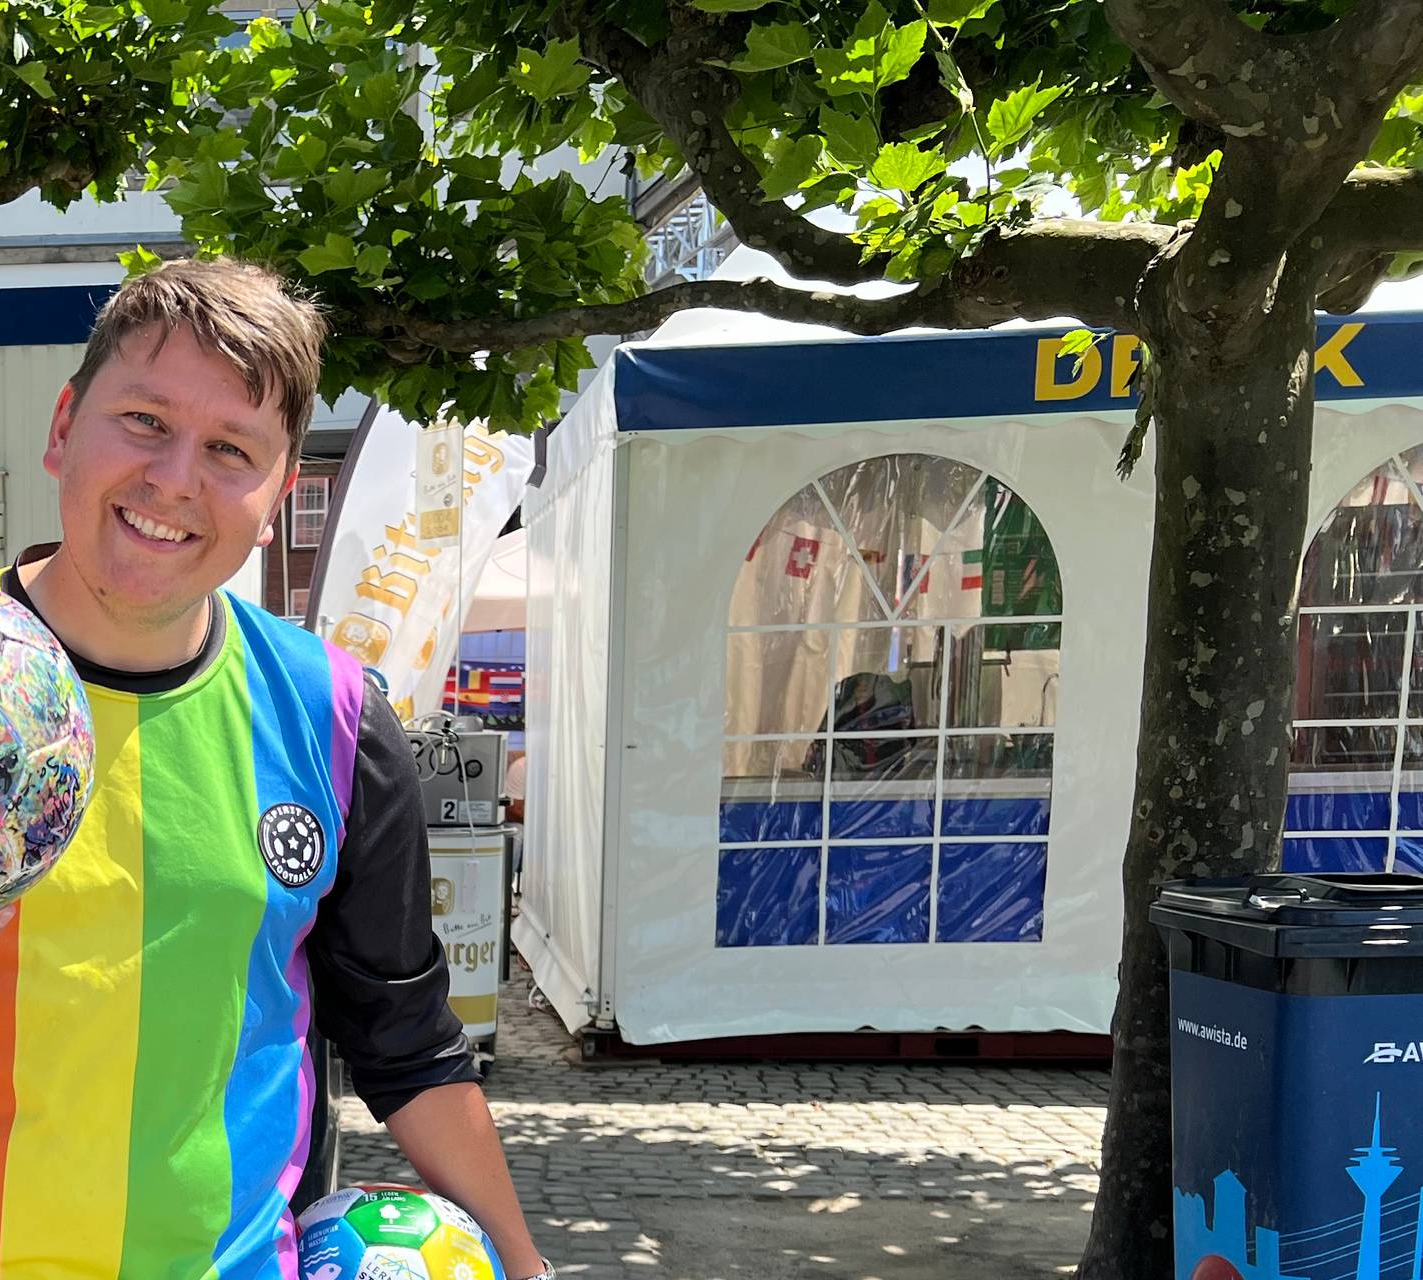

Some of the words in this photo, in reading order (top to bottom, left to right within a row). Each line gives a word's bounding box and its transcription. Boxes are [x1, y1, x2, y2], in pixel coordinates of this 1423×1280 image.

[265, 805, 302, 823] SPIRIT
[444, 801, 455, 820] 2
[271, 859, 314, 883] FOOTBALL
[1177, 1017, 1248, 1050] www.awista.de
[366, 1262, 392, 1280] LER
